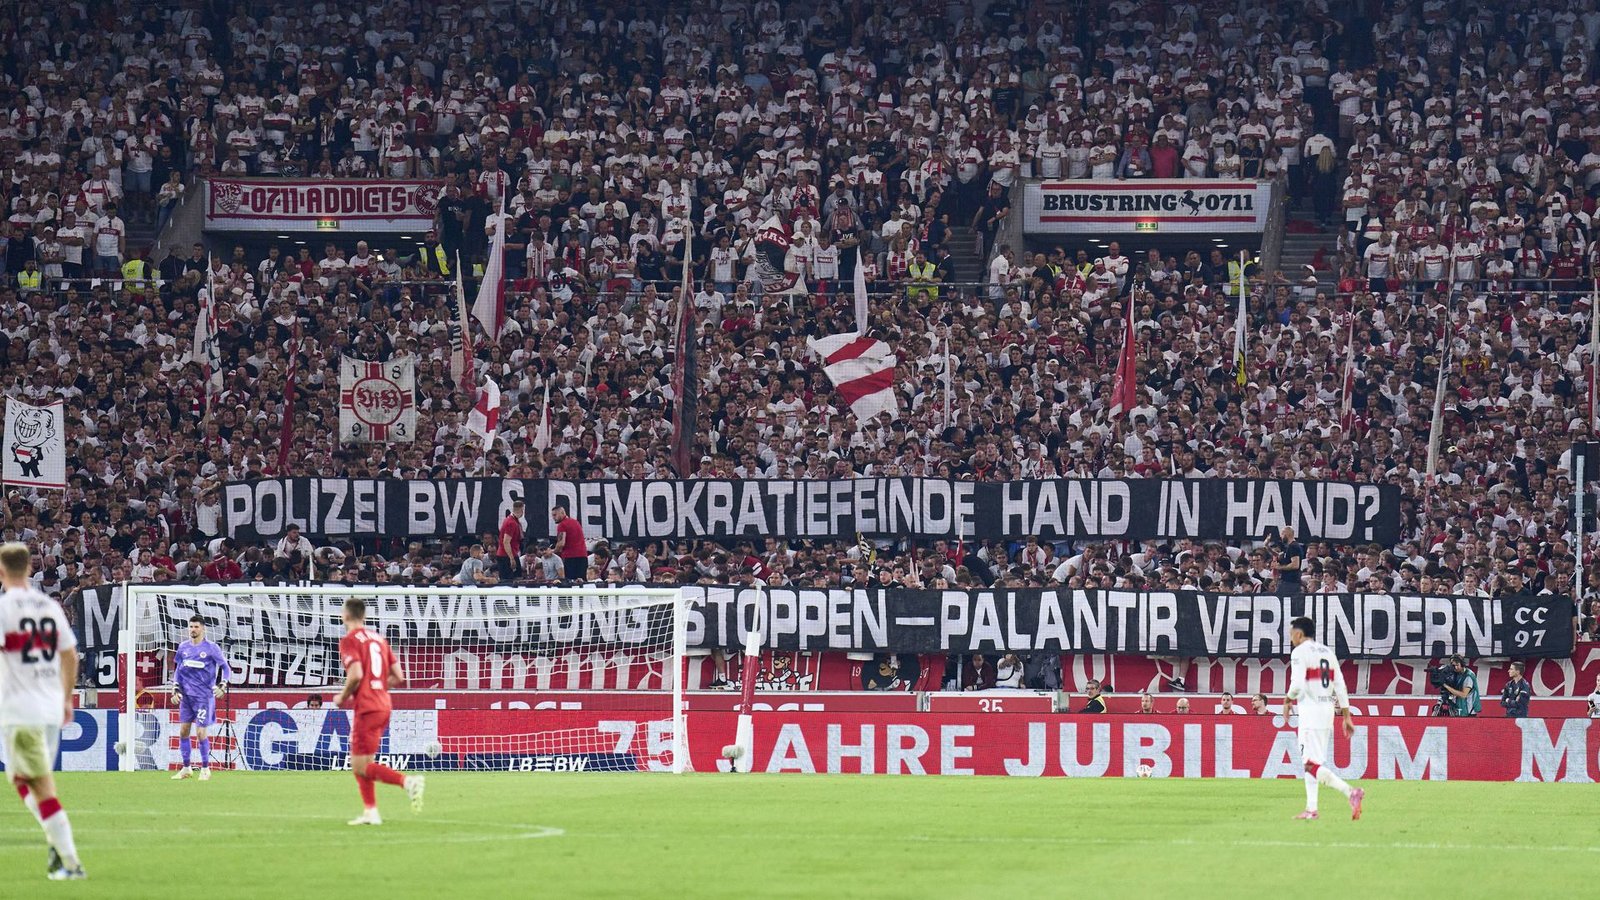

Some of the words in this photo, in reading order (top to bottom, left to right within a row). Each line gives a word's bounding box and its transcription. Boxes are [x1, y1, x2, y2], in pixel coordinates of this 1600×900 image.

[251, 187, 298, 213] 0711
[306, 187, 407, 214] ADDICTS
[1043, 193, 1178, 212] BRUSTRING
[1205, 194, 1254, 212] 0711
[391, 365, 402, 379] 8
[351, 422, 362, 437] 9
[396, 422, 406, 436] 3
[225, 478, 386, 539] POLIZEI
[408, 480, 483, 535] BW
[498, 478, 528, 533] &
[548, 478, 976, 537] DEMOKRATIEFEINDE
[1002, 480, 1131, 536] HAND
[1157, 480, 1199, 537] IN
[1226, 480, 1380, 541] HAND?
[681, 585, 889, 650] STOPPEN
[940, 589, 1179, 651] PALANTIR
[1196, 592, 1504, 657] VERHINDERN!
[1514, 606, 1549, 625] CC
[19, 617, 58, 664] 29
[1514, 629, 1547, 648] 97
[369, 641, 383, 678] 6
[1320, 658, 1330, 689] 8
[196, 708, 207, 719] 22
[597, 720, 682, 772] 75
[1004, 715, 1448, 781] JUBILÄUM
[1514, 717, 1600, 781] M
